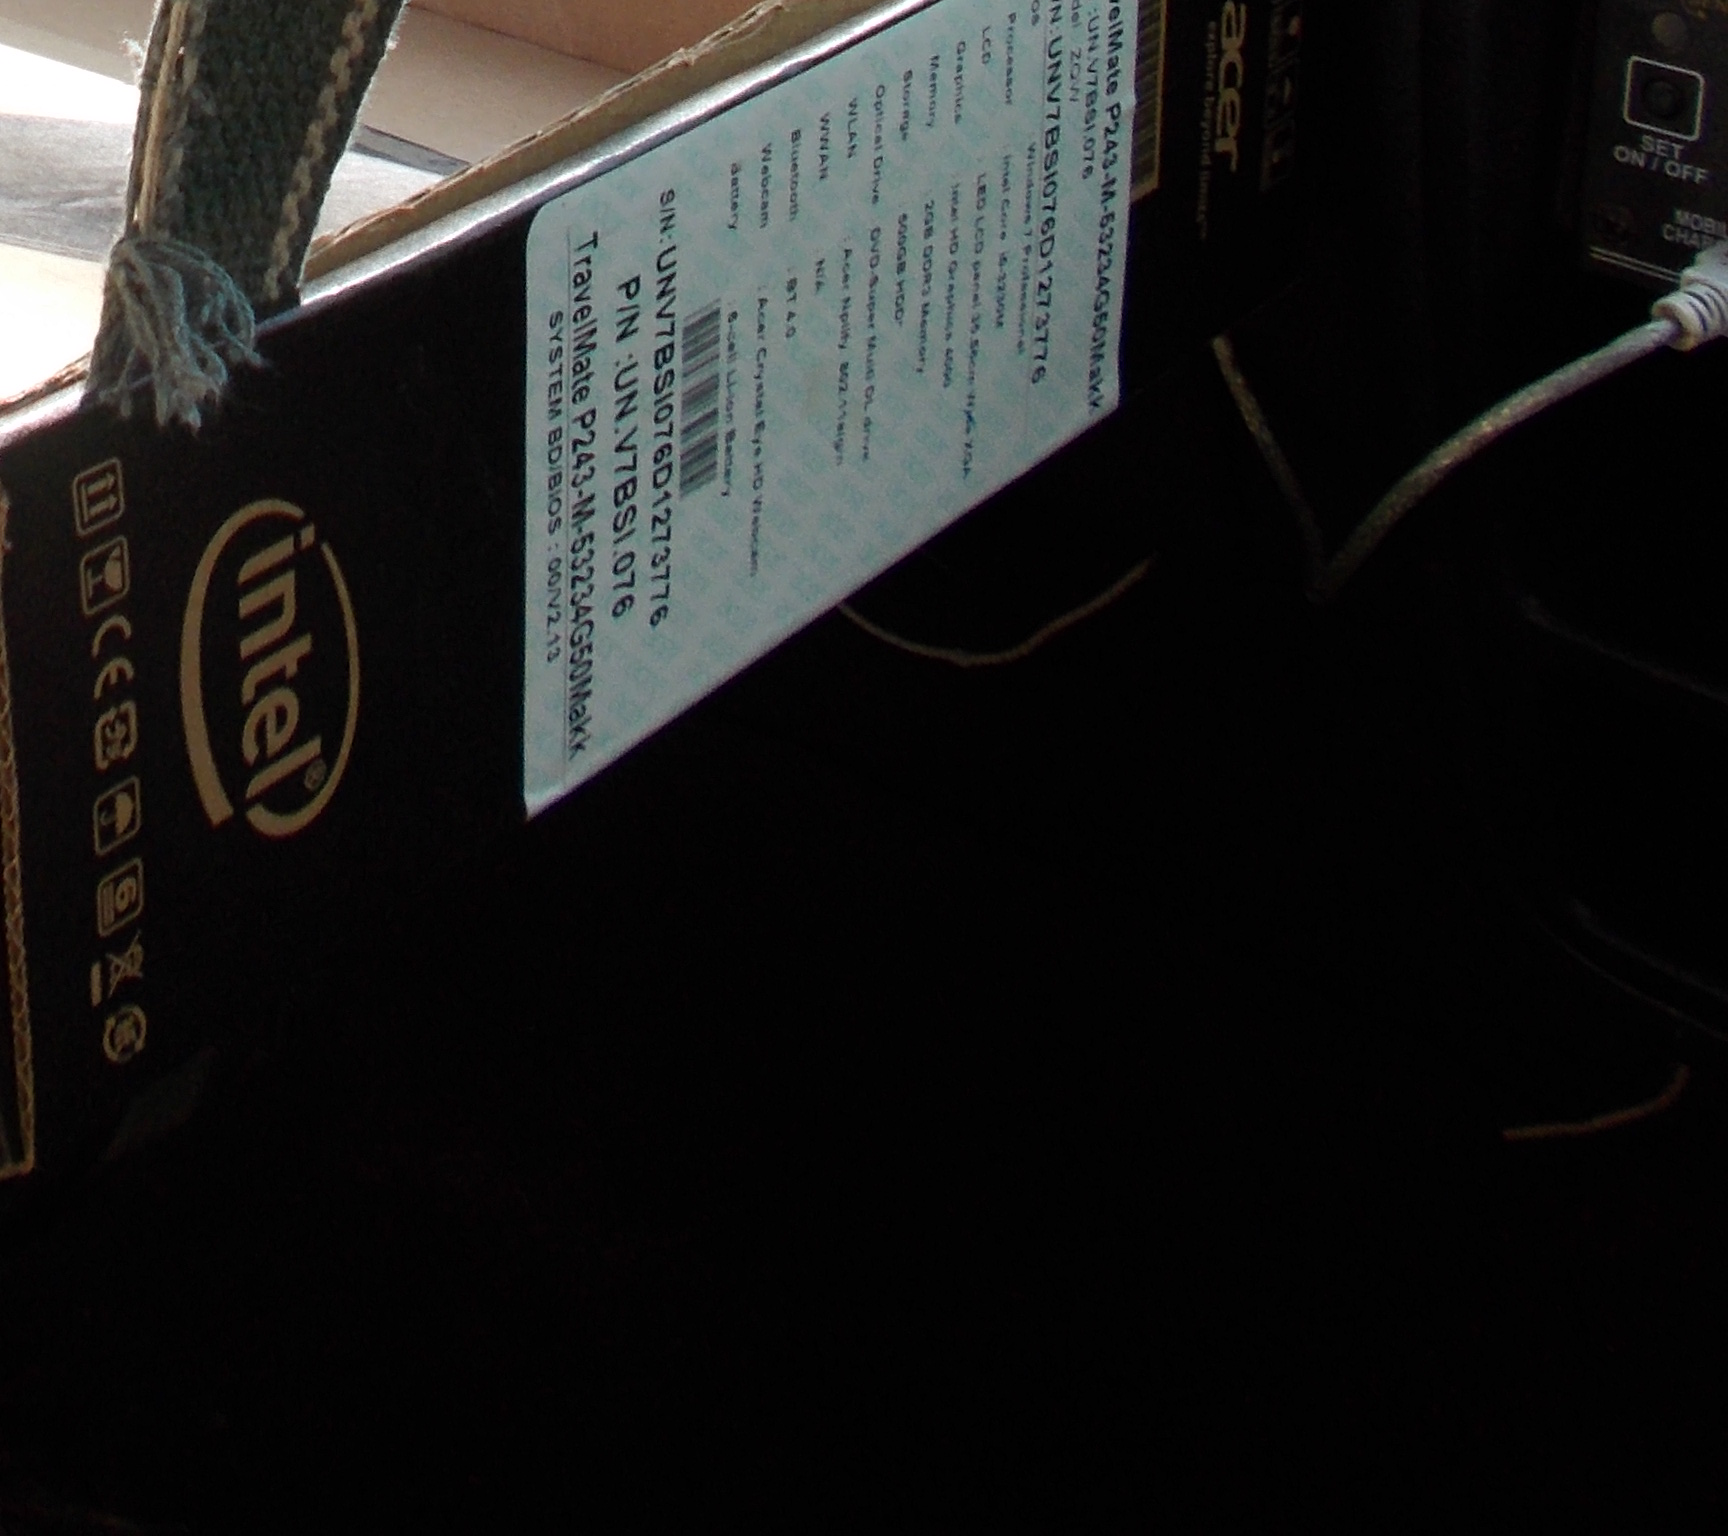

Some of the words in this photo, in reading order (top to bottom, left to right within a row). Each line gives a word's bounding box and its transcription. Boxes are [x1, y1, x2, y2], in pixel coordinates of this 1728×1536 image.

[981, 25, 992, 66] LCD
[1004, 11, 1017, 106] Processor
[924, 54, 941, 129] Memory
[953, 40, 967, 125] Graphics
[818, 111, 830, 182] WWAN
[846, 96, 859, 159] WLAN
[872, 83, 887, 152] Optical
[1640, 134, 1685, 160] SET
[727, 162, 742, 231] Battery
[759, 141, 773, 229] Webcam
[789, 128, 802, 222] Bluetooth
[871, 154, 884, 206] Drive
[975, 172, 987, 212] LED
[1613, 144, 1647, 169] ON
[1664, 159, 1710, 185] OFF
[841, 248, 853, 290] Acer
[948, 226, 959, 256] HD
[973, 215, 985, 255] LCD
[571, 230, 599, 405] TravelMate
[615, 274, 641, 344] P/N
[756, 297, 769, 341] Acer
[547, 310, 564, 421] SYSTEM
